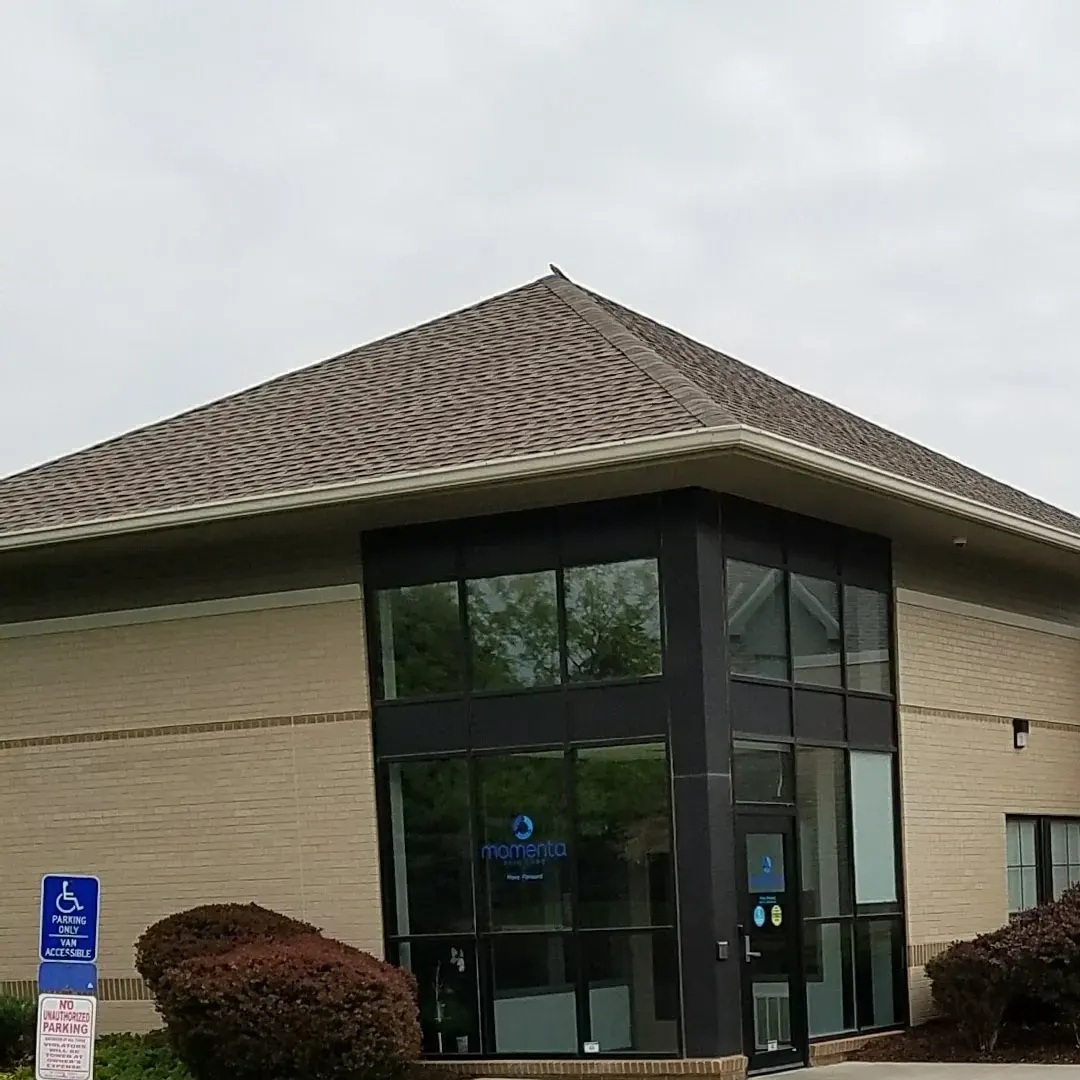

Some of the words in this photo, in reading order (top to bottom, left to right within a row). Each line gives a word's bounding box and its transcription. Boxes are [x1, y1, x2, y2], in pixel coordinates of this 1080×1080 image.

[481, 840, 568, 859] momenta
[52, 915, 87, 925] PARKING
[58, 925, 79, 935] ONLY
[60, 938, 77, 948] VAN
[44, 948, 92, 958] ACCESSIBLE
[59, 1000, 74, 1010] NO
[43, 1010, 90, 1023] UNAUTHORIZED
[43, 1022, 88, 1034] PARKING
